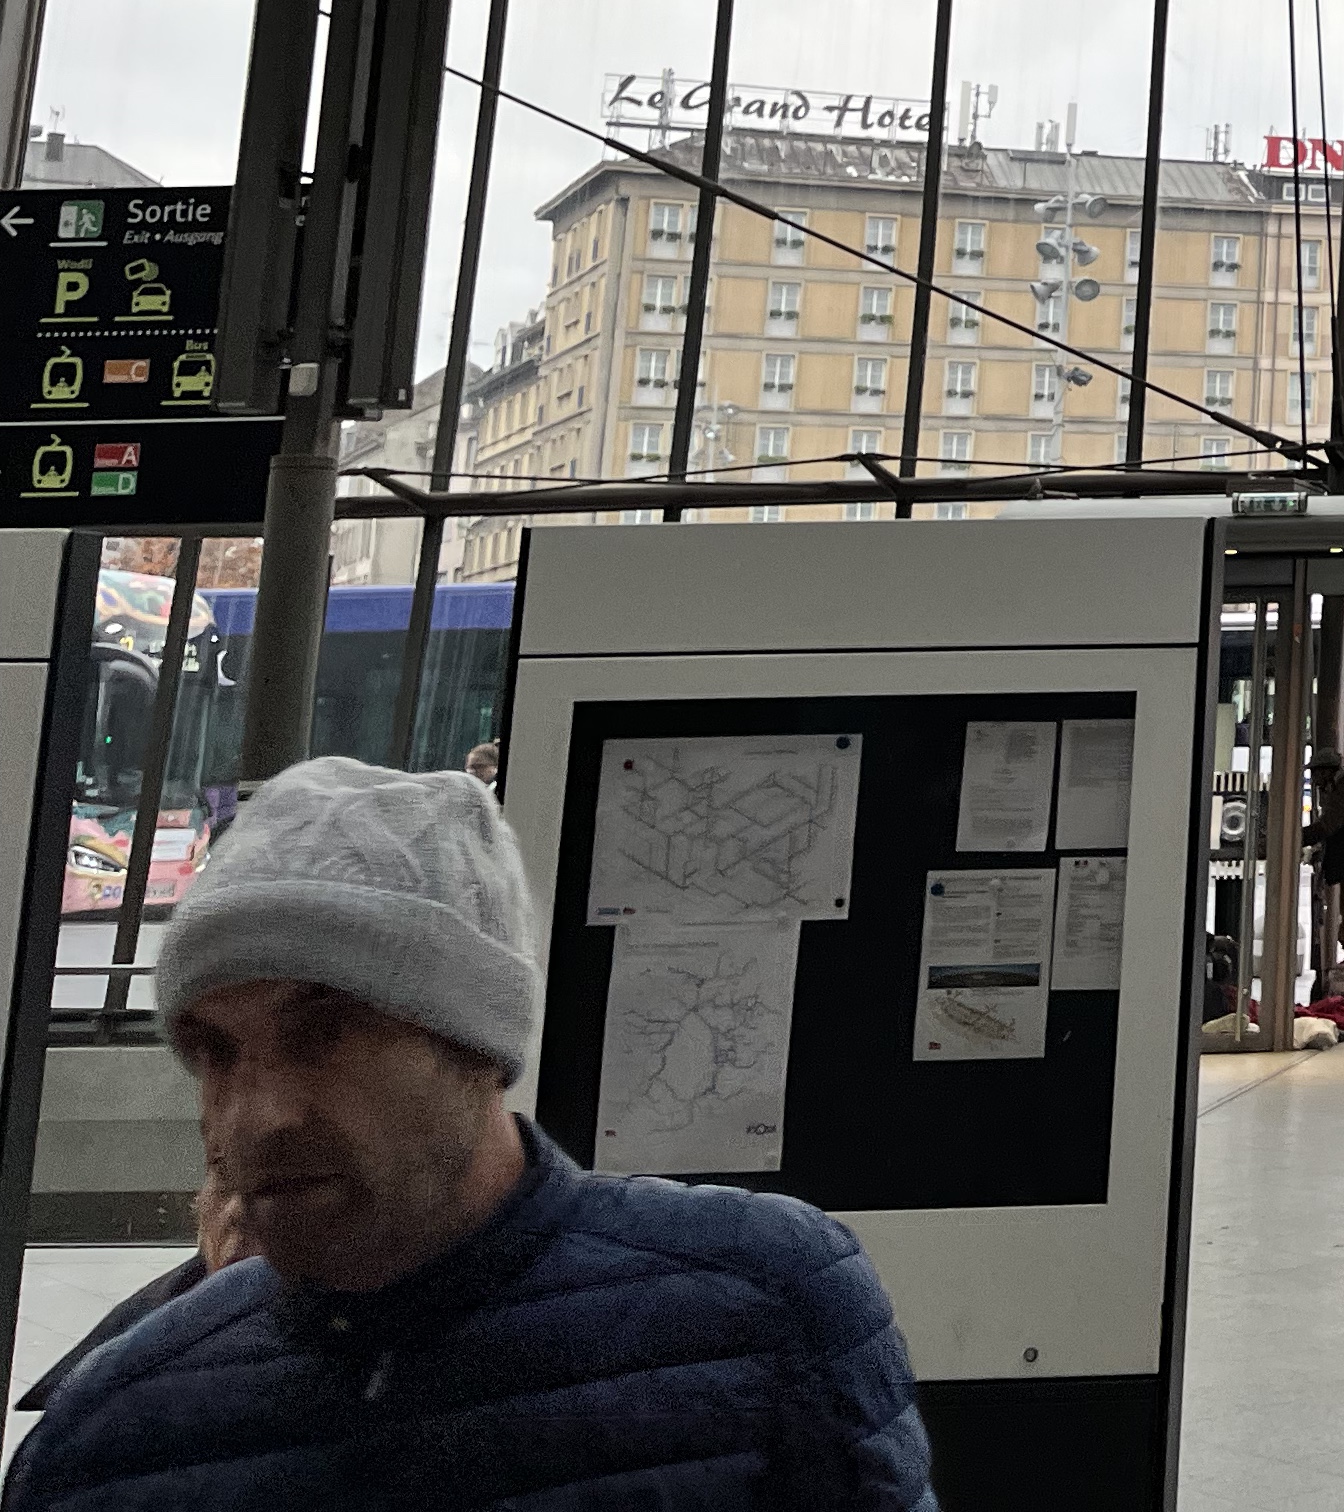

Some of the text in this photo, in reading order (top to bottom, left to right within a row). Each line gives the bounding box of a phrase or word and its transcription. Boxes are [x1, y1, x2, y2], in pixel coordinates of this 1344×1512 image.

[609, 74, 665, 110] Le
[824, 94, 932, 132] Hote
[126, 198, 212, 223] Sortie
[130, 361, 148, 380] C
[121, 445, 138, 466] A
[117, 474, 135, 493] D
